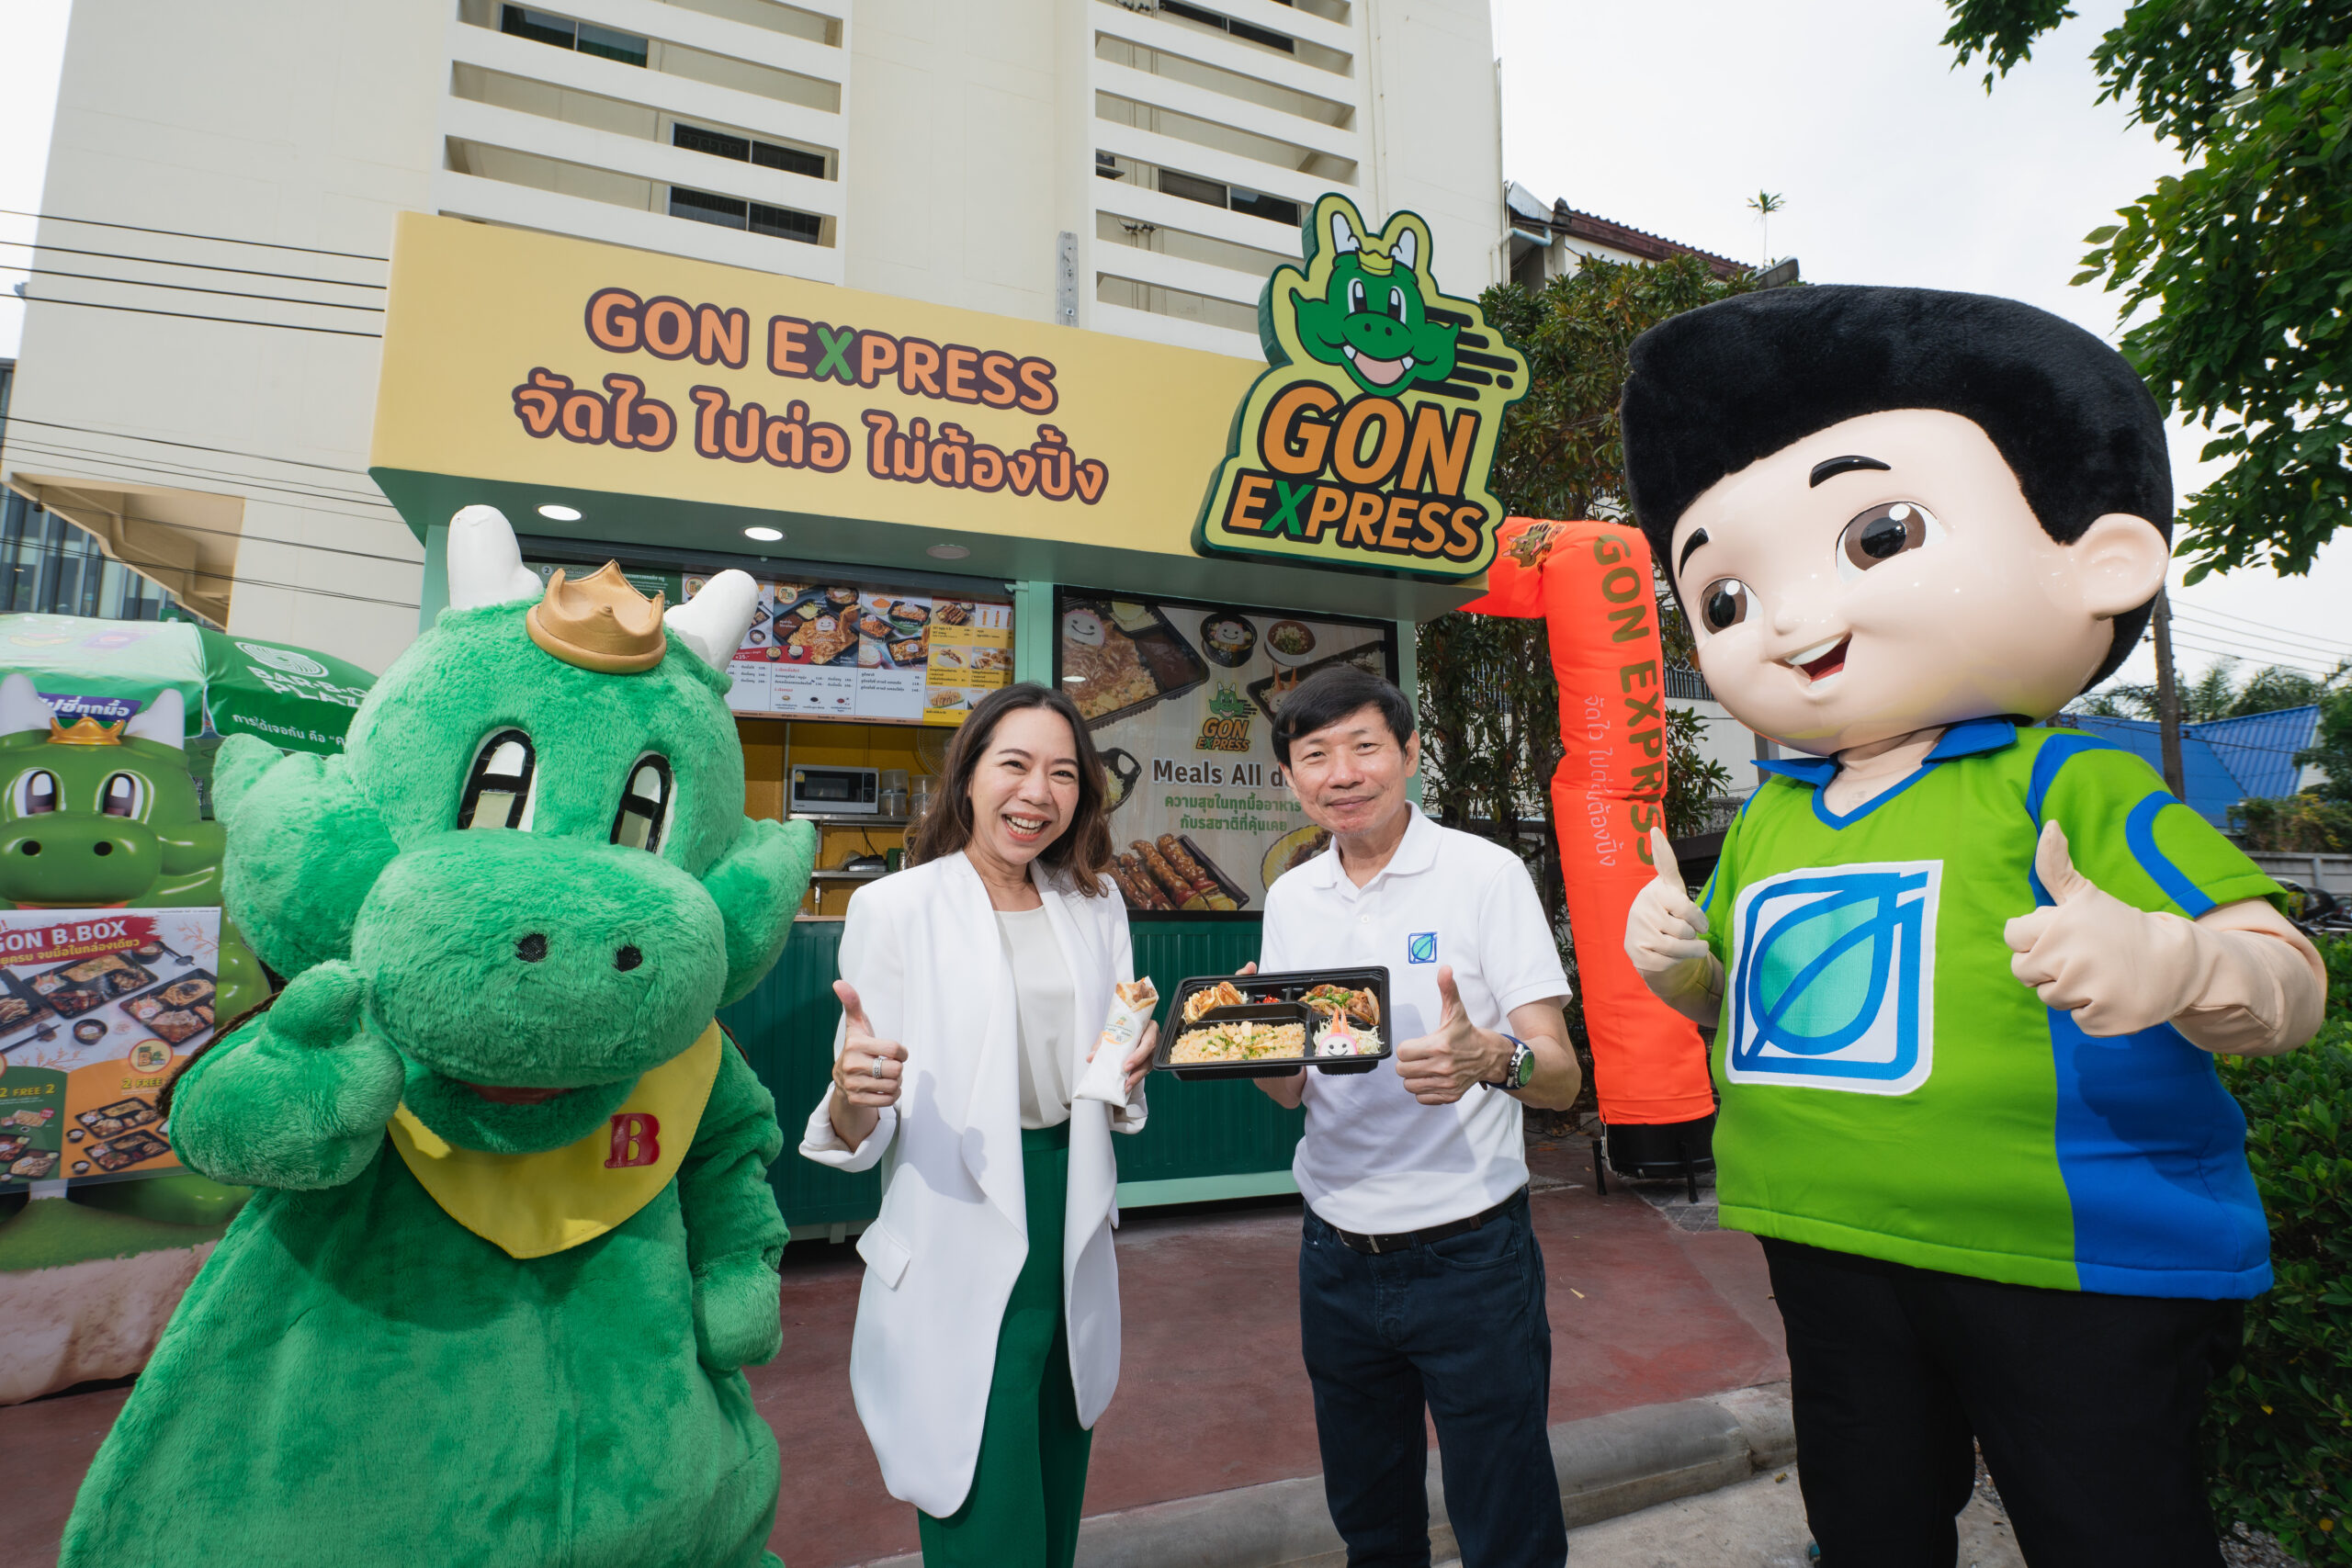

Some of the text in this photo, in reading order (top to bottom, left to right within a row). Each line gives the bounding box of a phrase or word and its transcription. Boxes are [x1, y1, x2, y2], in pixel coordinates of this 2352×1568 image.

[588, 290, 1057, 412] GON EXPRESS
[515, 370, 1106, 502] จัดไว ไปต่อ ไม่ต้องปิ้ง
[1260, 382, 1481, 499] GON
[1226, 471, 1487, 559] EXPRESS
[1593, 534, 1650, 643] GON
[262, 679, 362, 708] PLAZ
[1203, 717, 1250, 739] GON
[1584, 694, 1611, 741] จัดไว
[1195, 737, 1250, 751] EXPRESS
[1153, 760, 1289, 787] Meals All d
[1180, 814, 1288, 835] กับรสชาติที่คุ้นเคย
[52, 919, 128, 945] B.BOX
[13, 1087, 41, 1097] FREE
[45, 1083, 55, 1094] 2
[121, 1077, 163, 1089] 2 FREE
[605, 1112, 661, 1168] B
